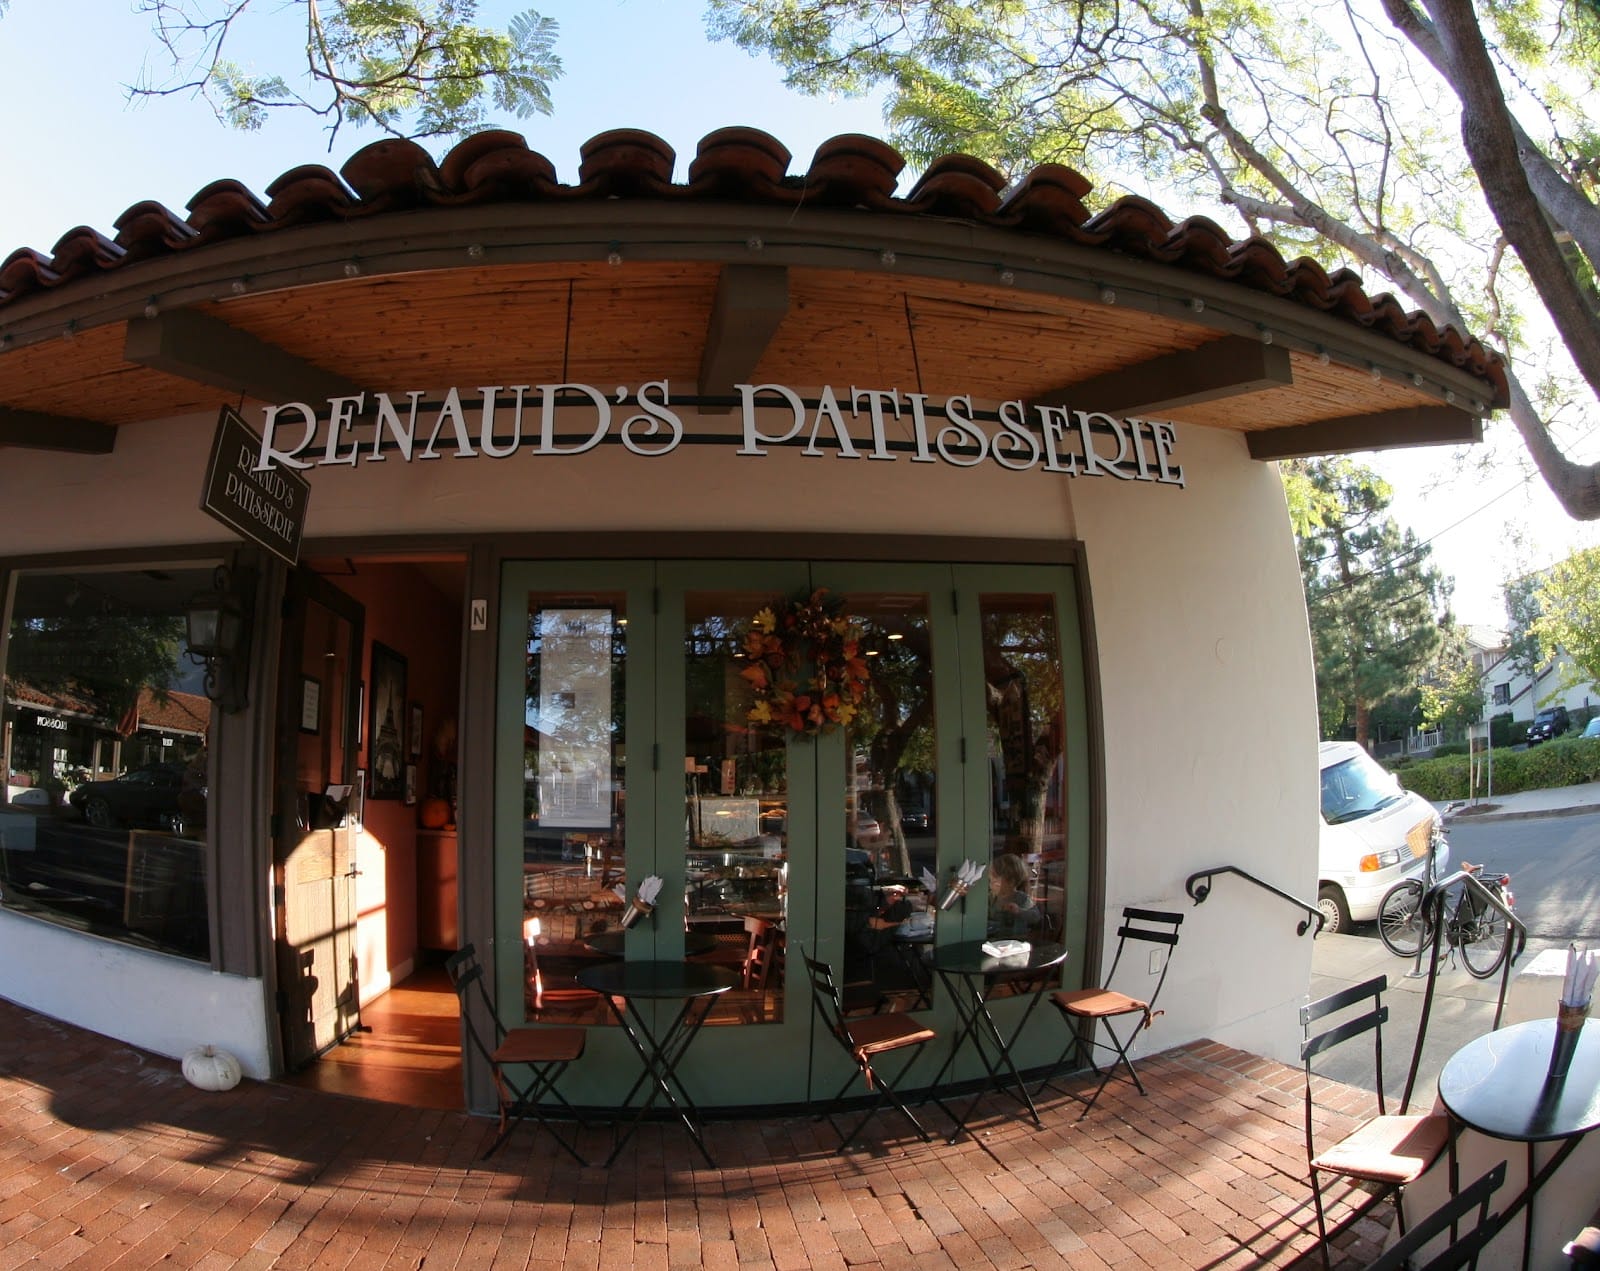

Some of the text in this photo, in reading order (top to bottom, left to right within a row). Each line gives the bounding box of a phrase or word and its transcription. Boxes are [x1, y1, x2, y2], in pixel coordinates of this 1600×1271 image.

[252, 379, 1186, 488] RENAUD'S PATISSERIE
[225, 472, 295, 544] PATISSERIE
[473, 607, 485, 625] N
